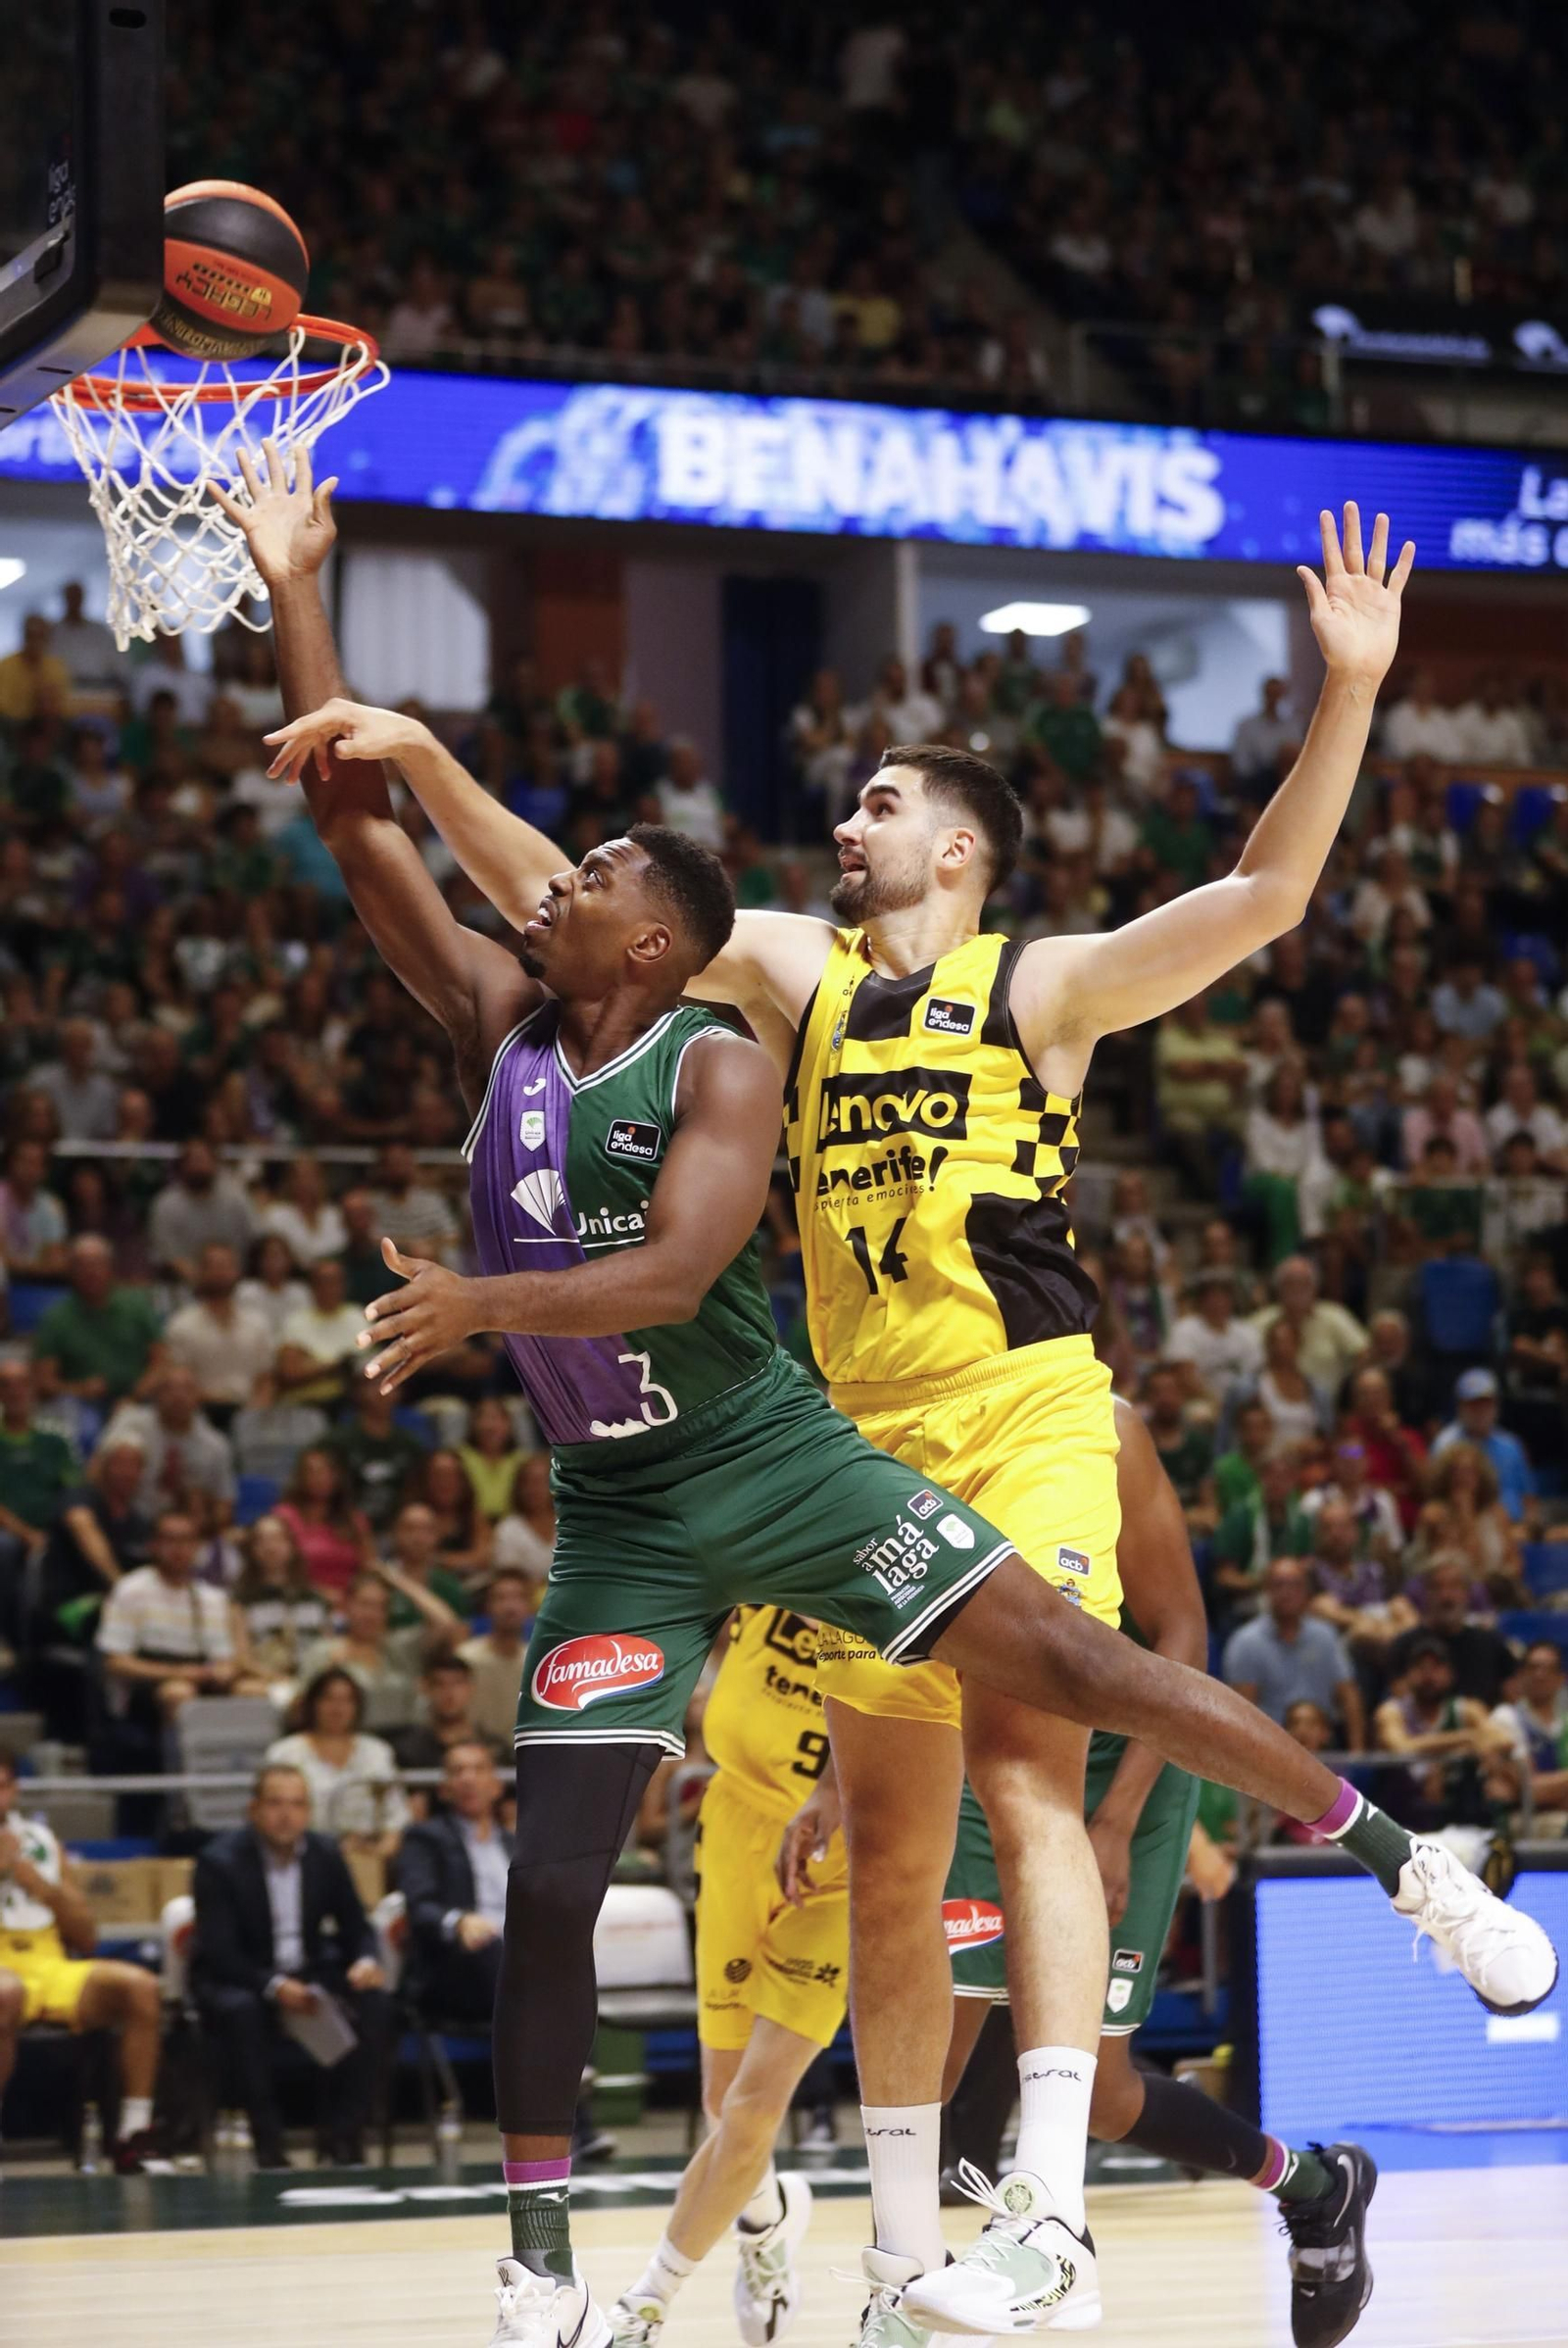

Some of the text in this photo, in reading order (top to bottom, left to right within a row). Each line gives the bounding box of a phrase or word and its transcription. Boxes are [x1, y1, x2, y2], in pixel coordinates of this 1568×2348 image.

[930, 1007, 950, 1021] liga
[928, 1017, 970, 1032] endesa
[612, 1130, 632, 1143] liga
[611, 1140, 654, 1156] endesa
[845, 1217, 908, 1296] 14
[919, 1499, 937, 1514] acb
[853, 1538, 878, 1565] sabor
[872, 1538, 940, 1595] laga
[1060, 1557, 1083, 1571] acb
[848, 1650, 876, 1662] para
[539, 1639, 659, 1696] famadesa
[791, 1730, 831, 1780] 9
